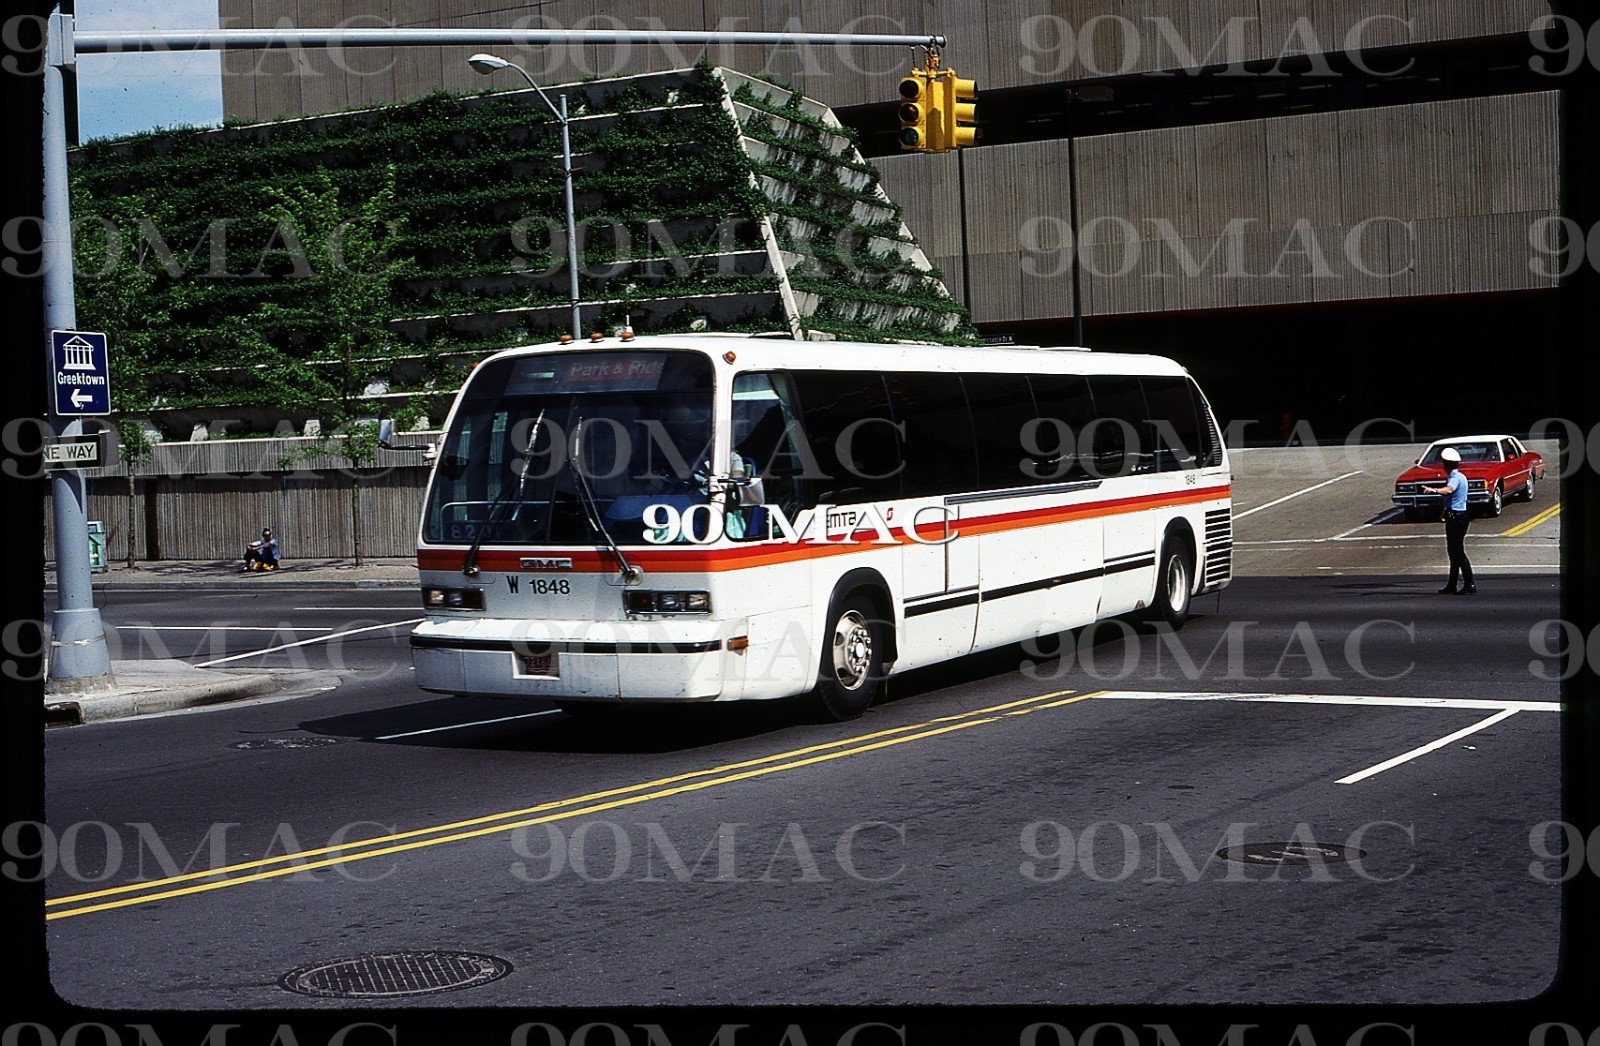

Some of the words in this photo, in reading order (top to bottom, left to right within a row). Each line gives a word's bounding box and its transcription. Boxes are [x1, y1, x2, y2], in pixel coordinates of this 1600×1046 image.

[570, 360, 609, 376] Park
[612, 363, 623, 374] &
[57, 371, 105, 385] Greektown
[43, 446, 60, 460] NE
[66, 445, 95, 459] WAY
[520, 557, 572, 569] GMC
[506, 575, 519, 594] W
[528, 579, 571, 595] 1848
